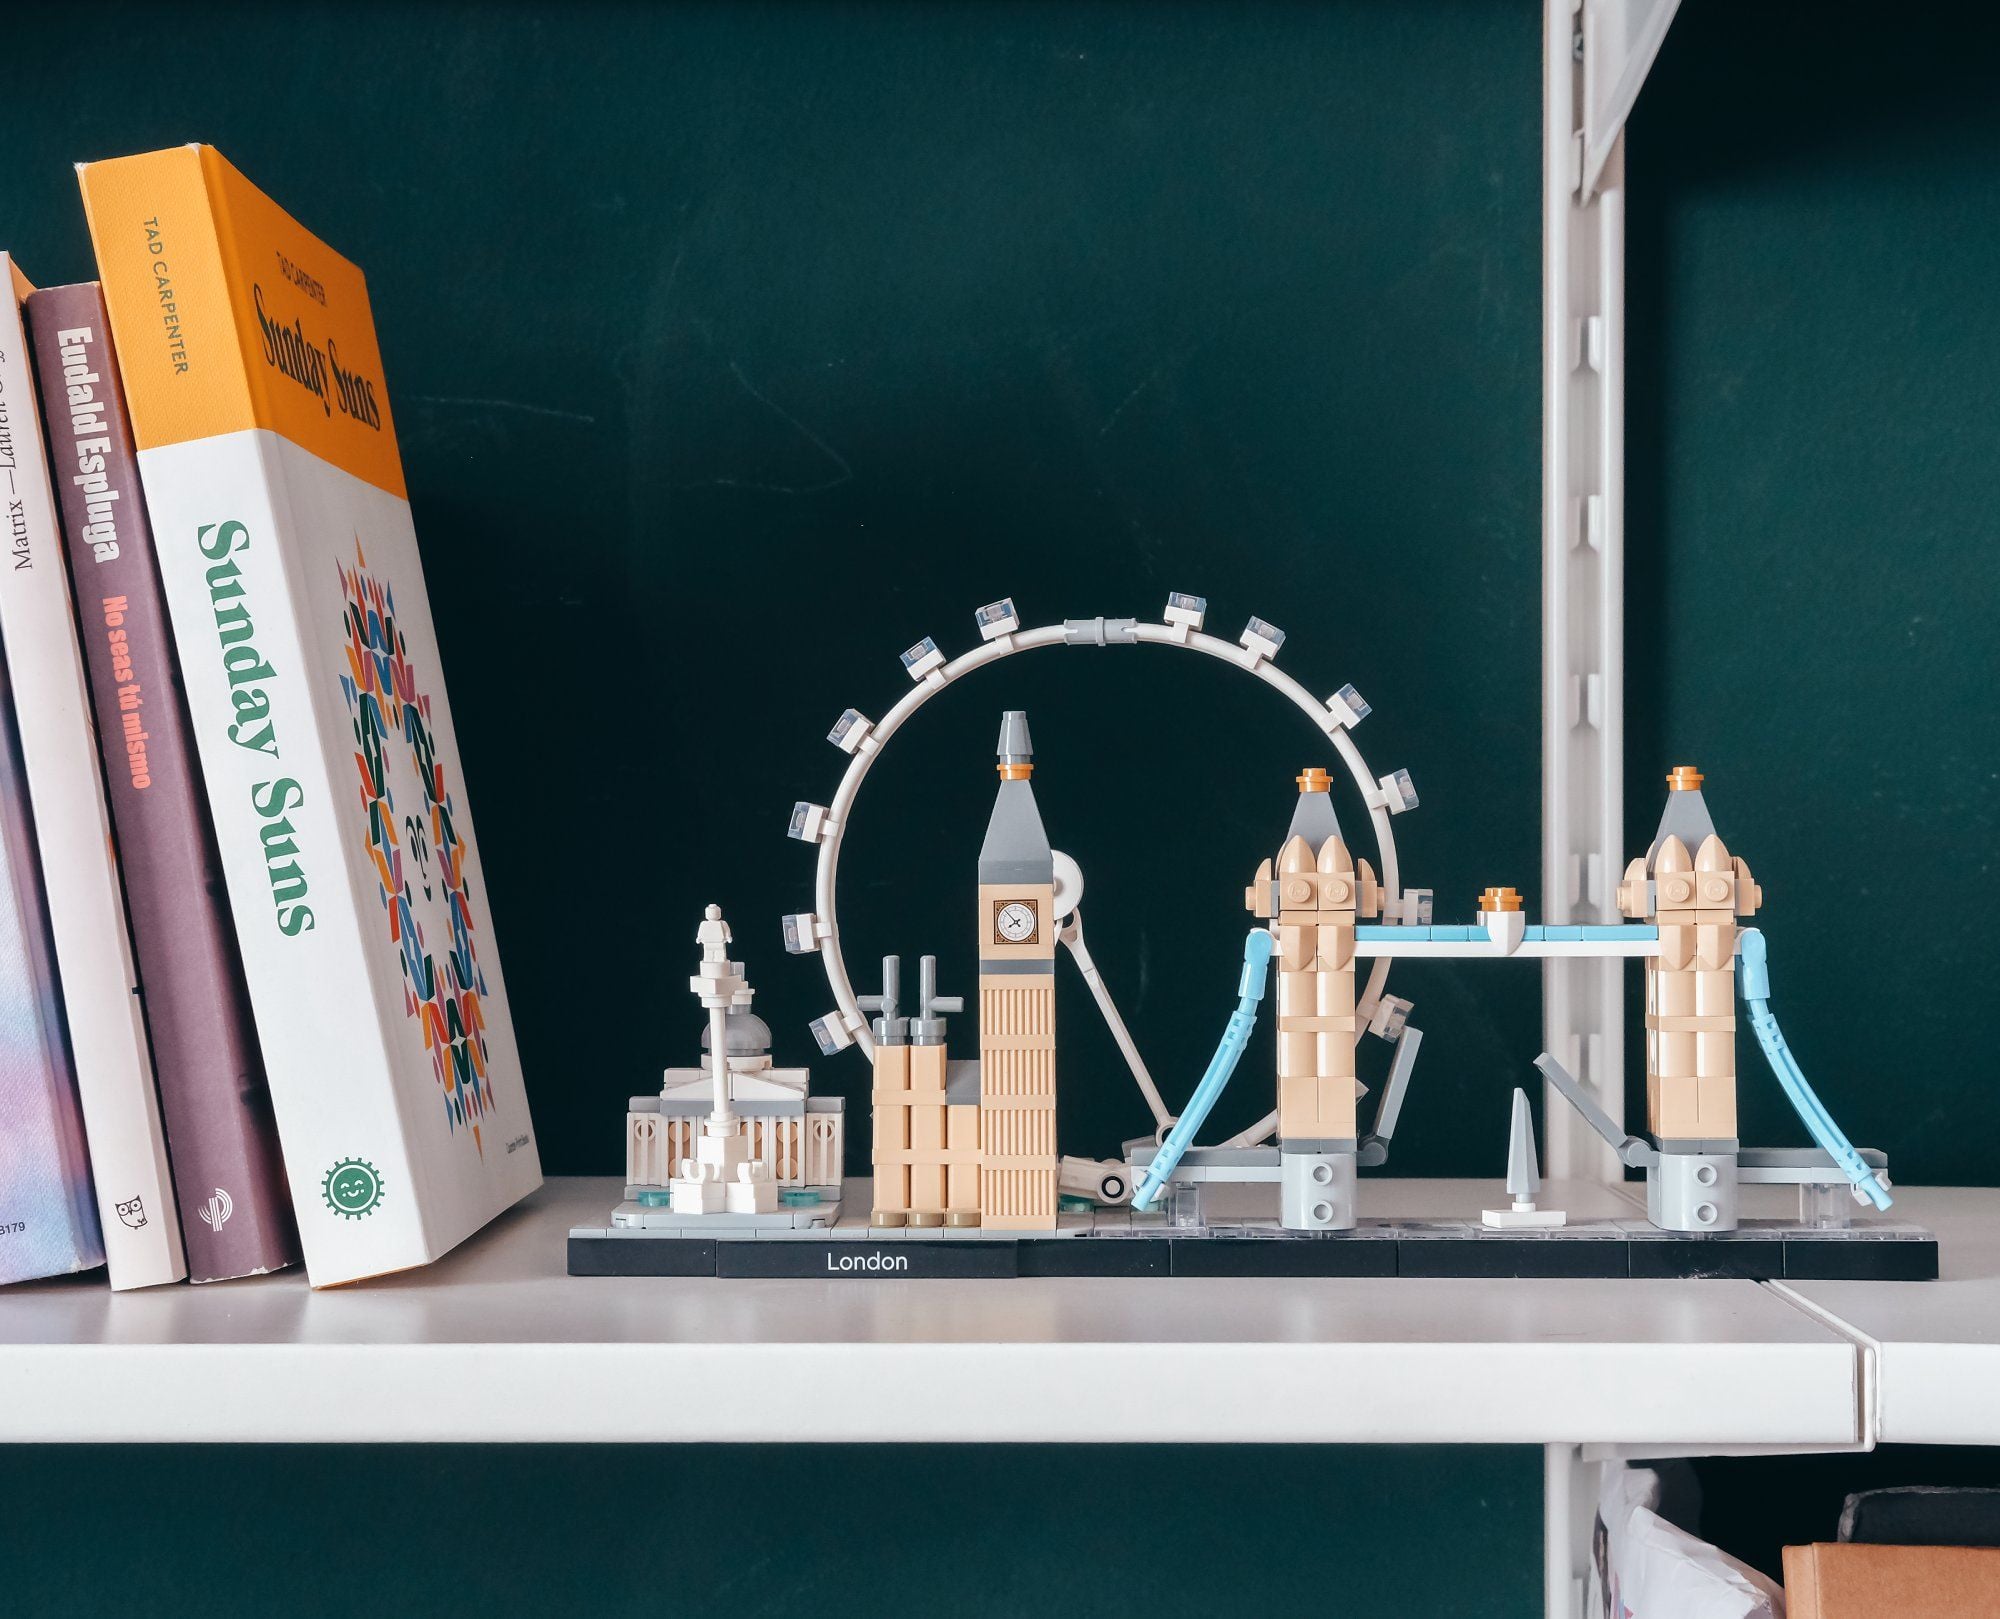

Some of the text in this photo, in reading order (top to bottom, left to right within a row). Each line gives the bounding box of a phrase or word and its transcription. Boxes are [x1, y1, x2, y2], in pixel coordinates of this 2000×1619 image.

[144, 216, 189, 376] TAD CARPENTER
[254, 282, 381, 432] Sunday Suns
[57, 326, 120, 564] Eudald Espluga
[6, 499, 33, 571] Matrix
[103, 595, 151, 790] No seas tú mismo
[197, 519, 315, 937] Sunday Suns
[827, 1251, 908, 1271] London
